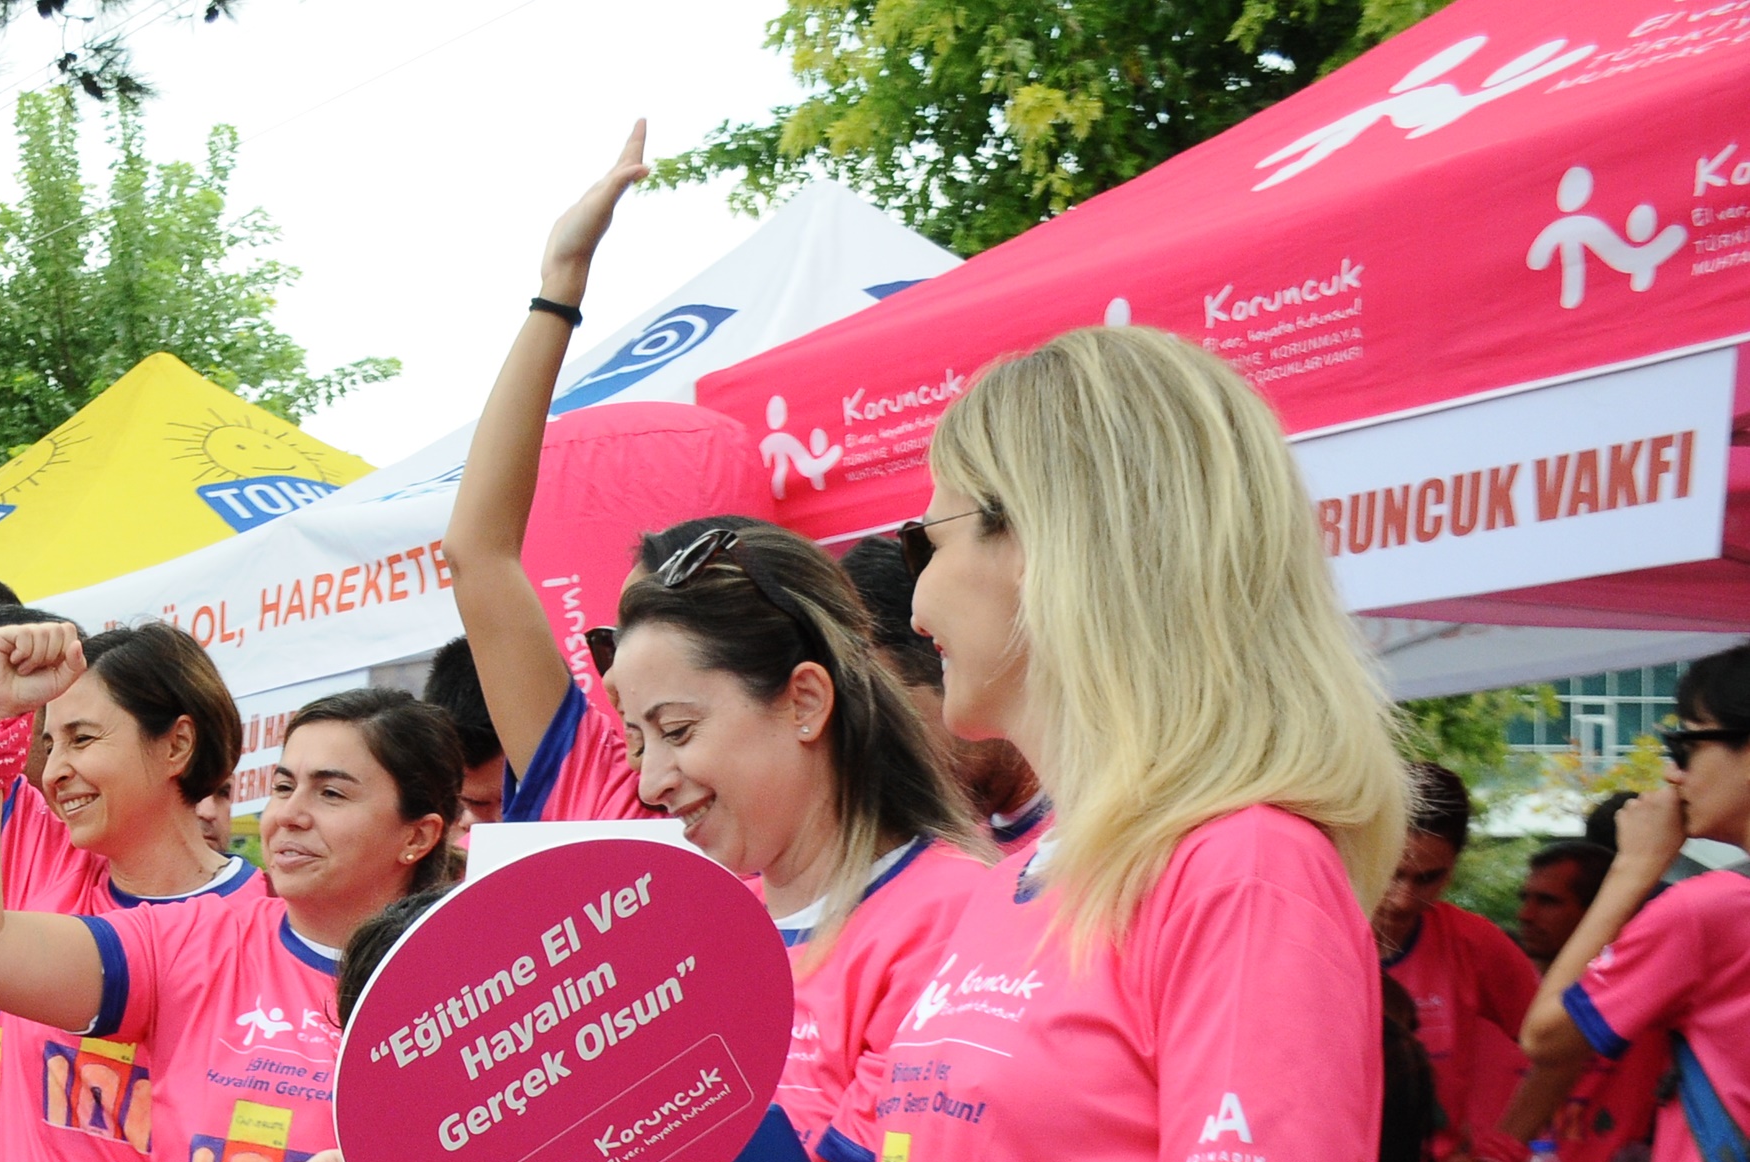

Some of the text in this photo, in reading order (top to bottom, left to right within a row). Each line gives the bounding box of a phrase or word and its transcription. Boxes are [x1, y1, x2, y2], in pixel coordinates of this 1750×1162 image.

[1203, 257, 1365, 329] Koruncuk
[842, 369, 965, 426] Koruncuk
[1318, 430, 1695, 557] RUNCUK VAKFI
[191, 601, 245, 649] OL,
[259, 539, 453, 632] HAREKETE
[540, 916, 582, 967] El
[582, 871, 653, 935] Ver
[459, 960, 618, 1082] Hayalim
[206, 1069, 270, 1092] Hayalim
[437, 1049, 573, 1153] Gerçek
[594, 1067, 722, 1157] Koruncuk
